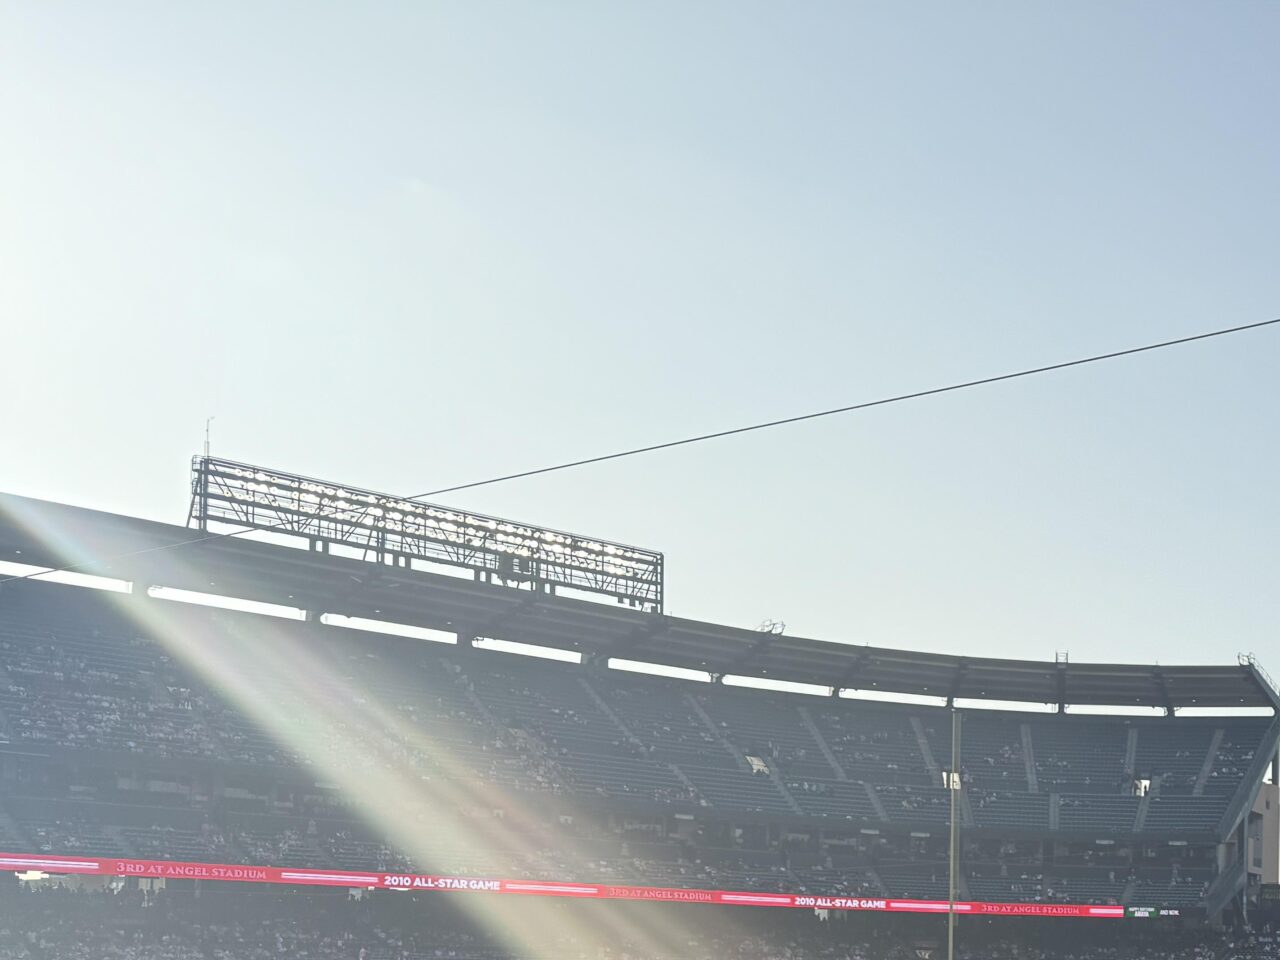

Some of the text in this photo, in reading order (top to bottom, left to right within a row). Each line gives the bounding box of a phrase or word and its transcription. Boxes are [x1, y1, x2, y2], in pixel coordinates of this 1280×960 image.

[116, 862, 267, 879] 3RD AT ANGEL STADIUM
[384, 876, 500, 890] 2010 ALL-STAR GAME
[608, 887, 712, 901] 3RD AT ANGEL STADIUM
[795, 896, 887, 909] 2010 ALL-STAR GAME
[981, 904, 1080, 915] 3RD AT ANGEL STADIUM
